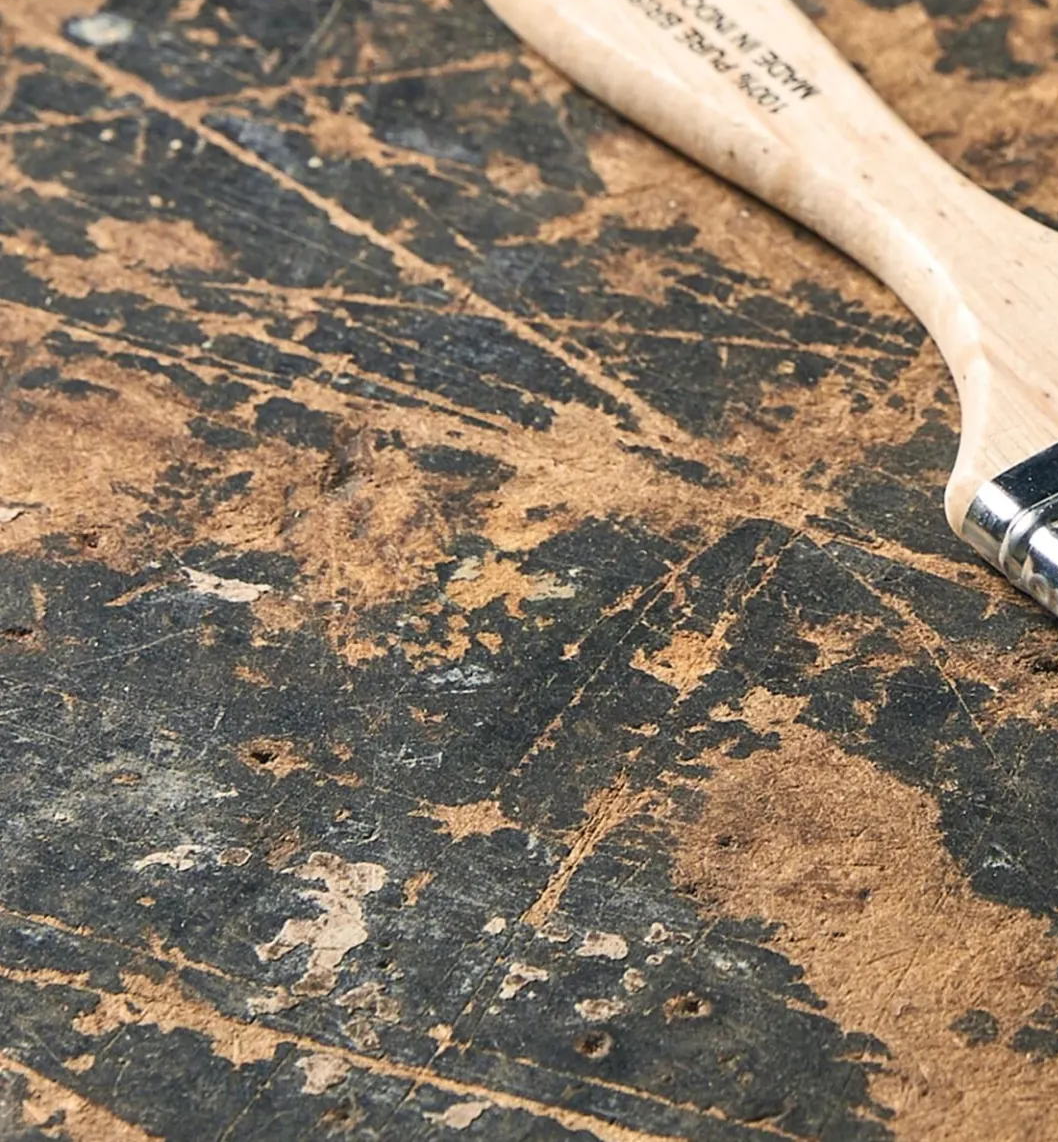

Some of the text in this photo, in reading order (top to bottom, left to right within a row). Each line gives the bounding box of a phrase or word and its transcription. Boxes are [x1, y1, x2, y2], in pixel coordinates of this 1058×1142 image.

[674, 25, 739, 74] PURE
[729, 32, 762, 55] IN
[753, 49, 821, 100] MADE
